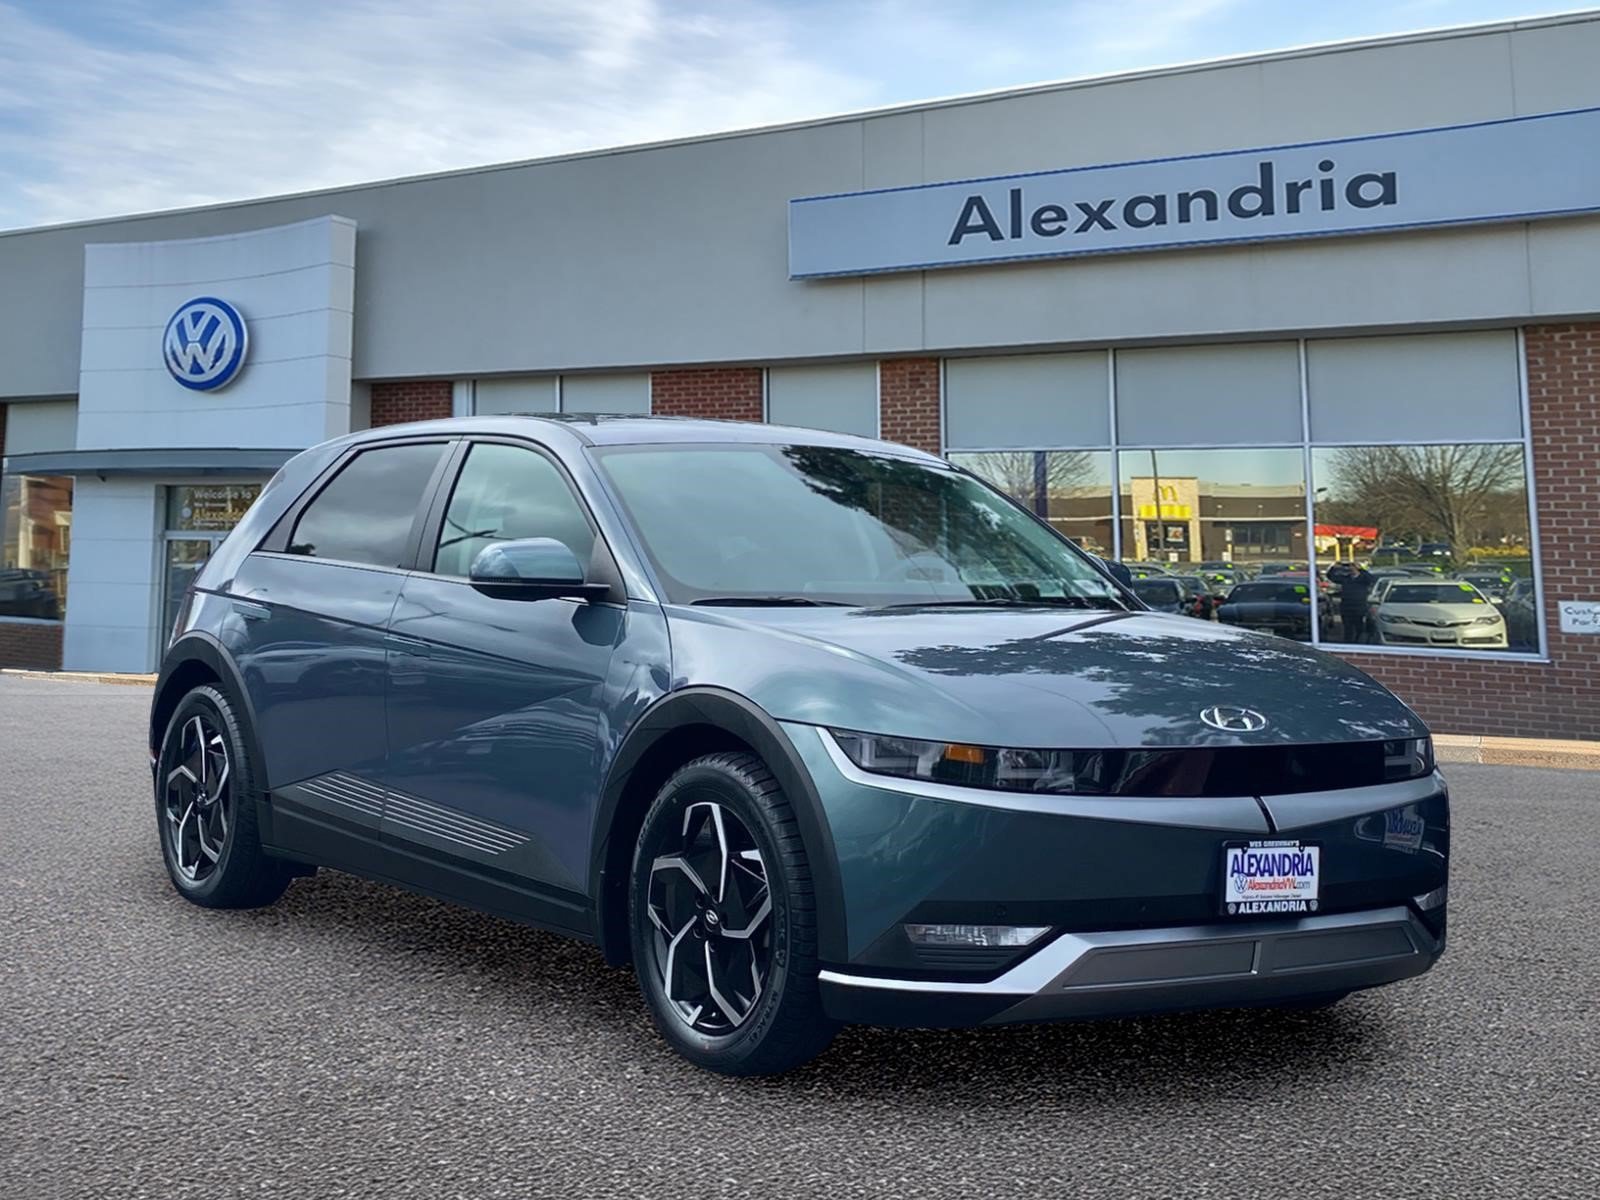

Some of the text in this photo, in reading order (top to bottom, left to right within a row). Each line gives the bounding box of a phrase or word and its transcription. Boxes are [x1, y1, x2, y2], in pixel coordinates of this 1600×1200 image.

[948, 160, 1397, 246] Alexandria
[193, 508, 244, 521] Alexand
[1230, 853, 1314, 878] ALEXANDRIA
[1238, 900, 1308, 914] ALEXANDRIA
